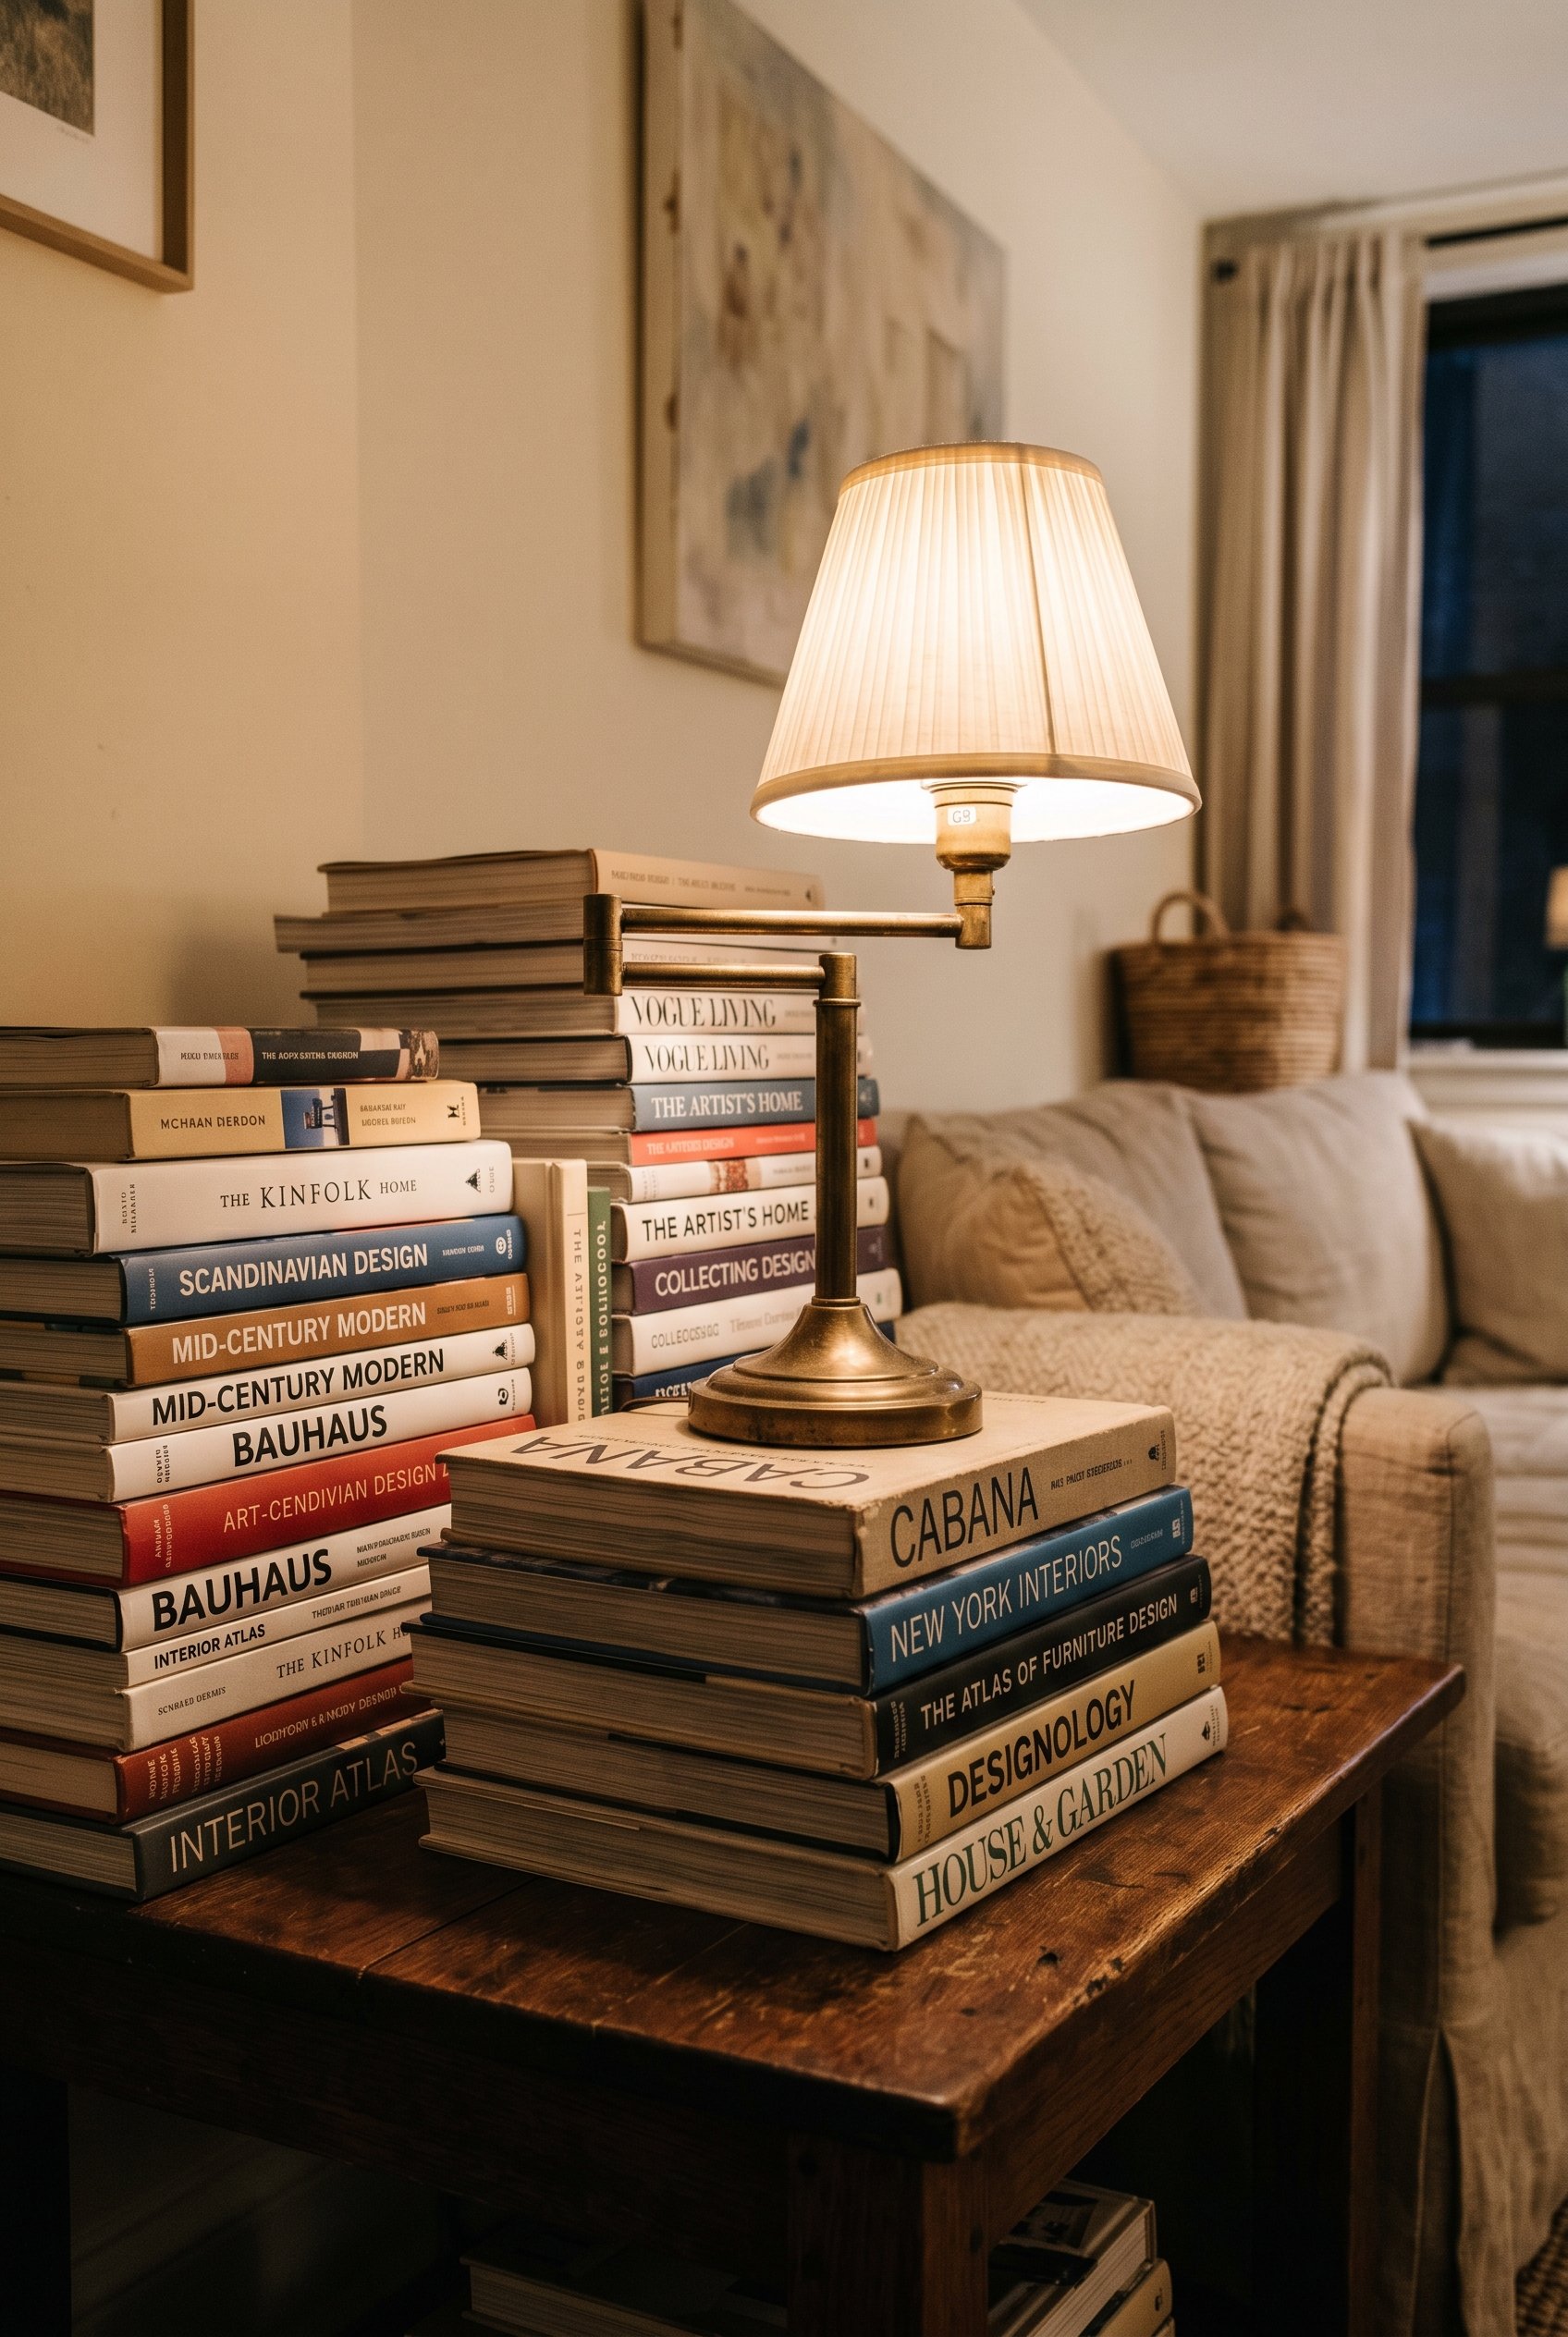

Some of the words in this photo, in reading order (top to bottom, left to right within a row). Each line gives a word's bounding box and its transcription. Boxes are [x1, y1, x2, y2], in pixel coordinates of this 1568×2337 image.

[631, 996, 705, 1027] VOGUE
[709, 998, 776, 1028] LIVING
[643, 1045, 711, 1072] VOGUE
[712, 1045, 769, 1071] LIVING
[651, 1095, 687, 1119] THE
[689, 1093, 758, 1116] ARTIST'S
[758, 1091, 803, 1112] HOME
[220, 1193, 251, 1208] THE
[260, 1180, 372, 1209] KINFOLK
[379, 1180, 417, 1194] HOME
[642, 1216, 678, 1242] THE
[683, 1207, 757, 1237] ARTIST'S
[762, 1201, 809, 1226] HOME
[178, 1249, 349, 1297] SCANDINAVIAN
[353, 1242, 428, 1273] DESIGN
[655, 1256, 759, 1297] COLLECTING
[761, 1248, 815, 1279] DESIGN
[172, 1311, 333, 1364] MID-CENTURY
[337, 1302, 426, 1337] MODERN
[152, 1367, 335, 1425] MID-CENTURY
[343, 1348, 444, 1390] MODERN
[232, 1404, 387, 1467] BAUHAUS
[511, 1436, 870, 1489] CABANA
[224, 1478, 368, 1533] ART-CENDIVIAN
[374, 1462, 436, 1496] DESIGN
[890, 1466, 1039, 1569] CABANA
[152, 1548, 332, 1632] BAUHAUS
[888, 1609, 944, 1664] NEW
[951, 1580, 1013, 1638] YORK
[1019, 1535, 1122, 1609] INTERIORS
[153, 1638, 221, 1670] INTERIOR
[224, 1623, 266, 1649] ATLAS
[276, 1658, 305, 1679] THE
[311, 1630, 386, 1669] KINFOLK
[920, 1693, 955, 1730] THE
[961, 1670, 1013, 1712] ATLAS
[1018, 1658, 1037, 1687] OF
[1043, 1616, 1124, 1675] FURNITURE
[1129, 1593, 1178, 1636] DESIGN
[949, 1680, 1136, 1818] DESIGNOLOGY
[170, 1780, 321, 1874] INTERIOR
[329, 1742, 419, 1808] ATLAS
[914, 1806, 1027, 1929] HOUSE
[1031, 1807, 1053, 1851] &
[1057, 1731, 1168, 1839] GARDEN
